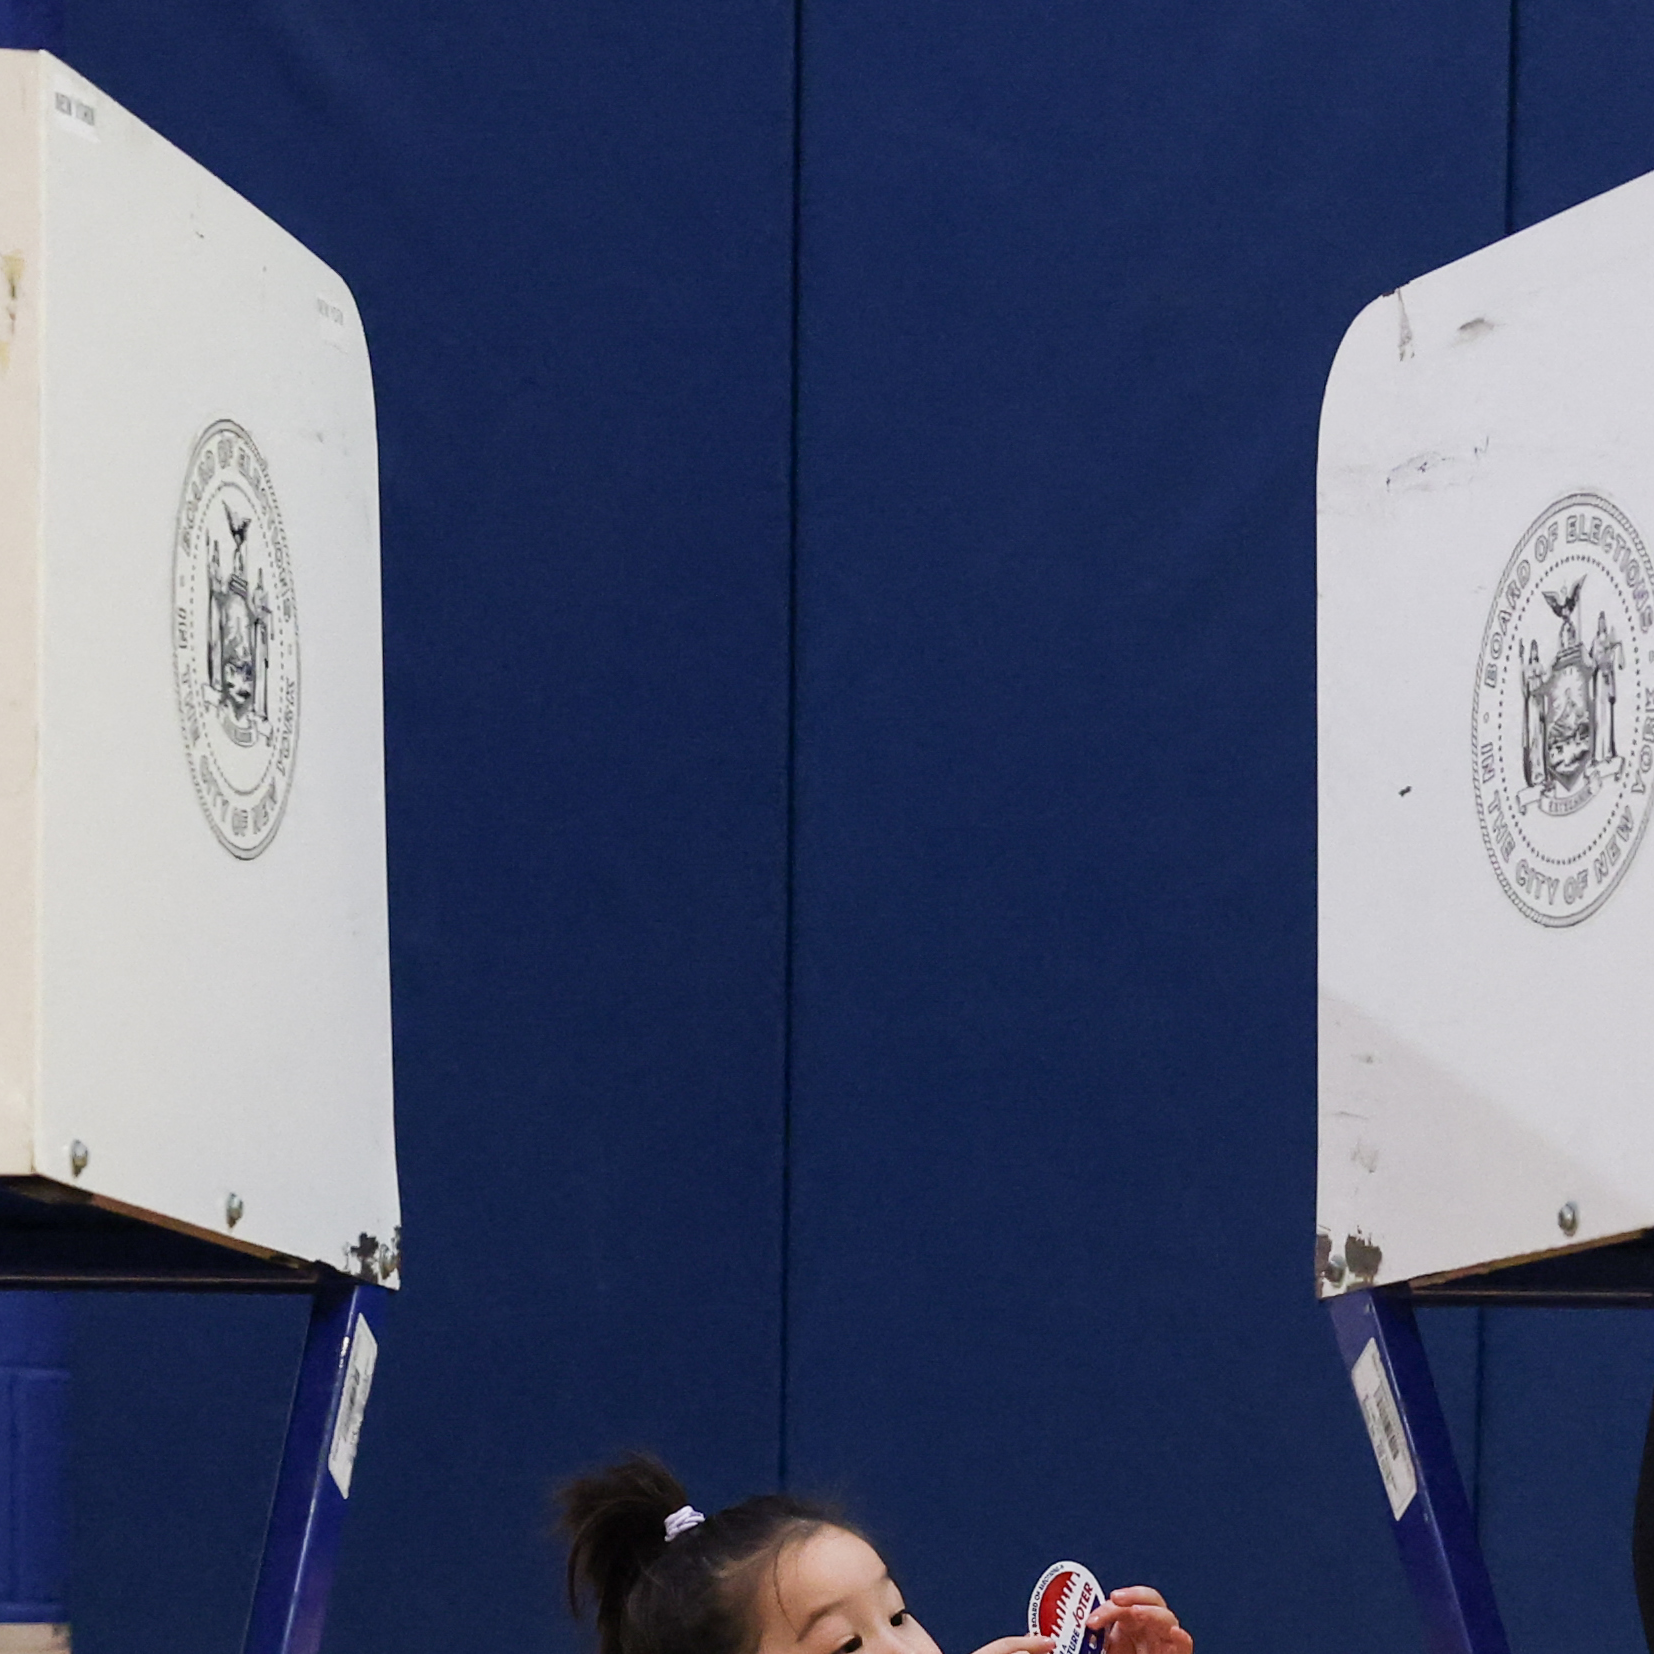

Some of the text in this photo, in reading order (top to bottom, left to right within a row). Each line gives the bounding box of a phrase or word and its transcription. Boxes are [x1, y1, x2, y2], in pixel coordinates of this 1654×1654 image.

[1484, 514, 1654, 688] BOARD OF ELECTIONS
[1481, 741, 1496, 784] IN
[1488, 789, 1516, 863] THE
[1594, 805, 1634, 884] NEW
[1515, 858, 1560, 905] CITY
[1563, 868, 1589, 905] OF
[1031, 1602, 1039, 1628] BOARD
[1072, 1582, 1093, 1630] VOTER
